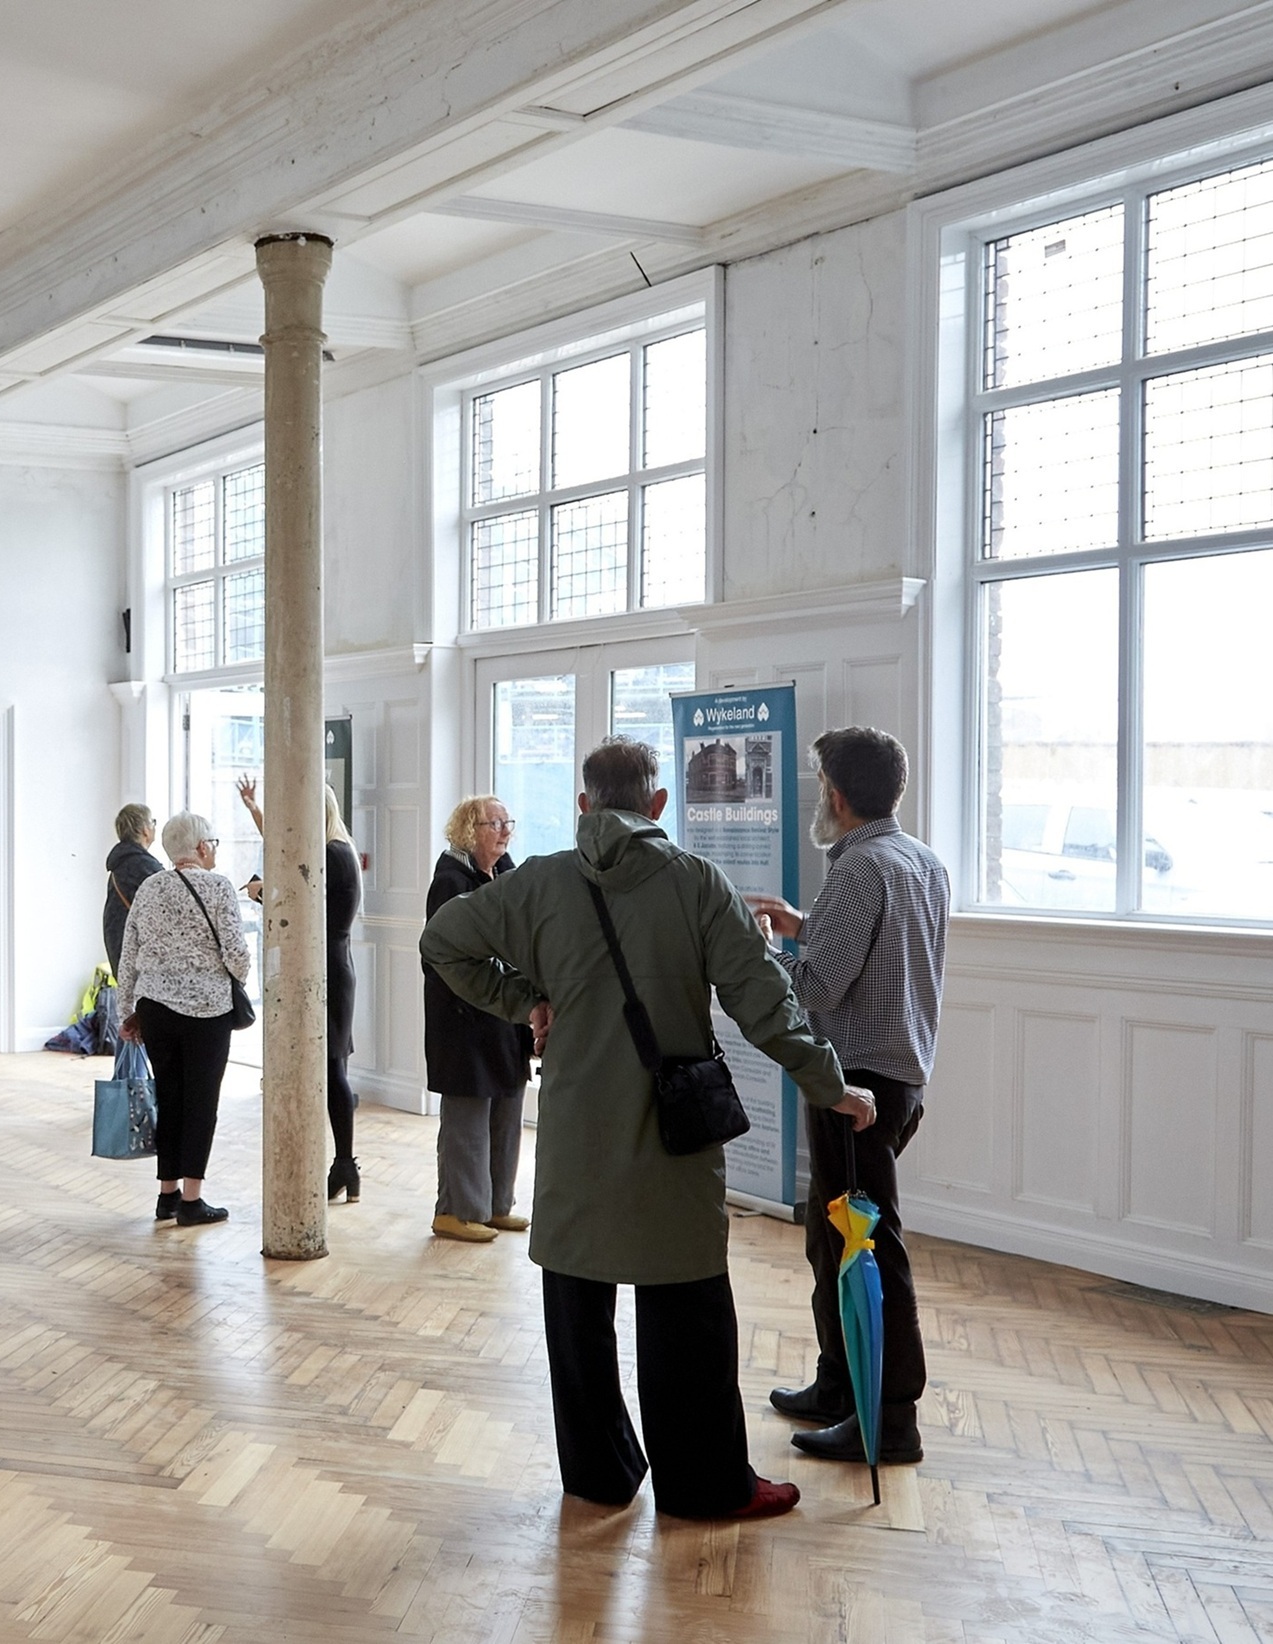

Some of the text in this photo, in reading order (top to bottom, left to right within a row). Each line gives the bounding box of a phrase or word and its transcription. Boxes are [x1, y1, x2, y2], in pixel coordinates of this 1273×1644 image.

[706, 705, 755, 725] Wykeland
[687, 806, 778, 825] Castle Buildings
